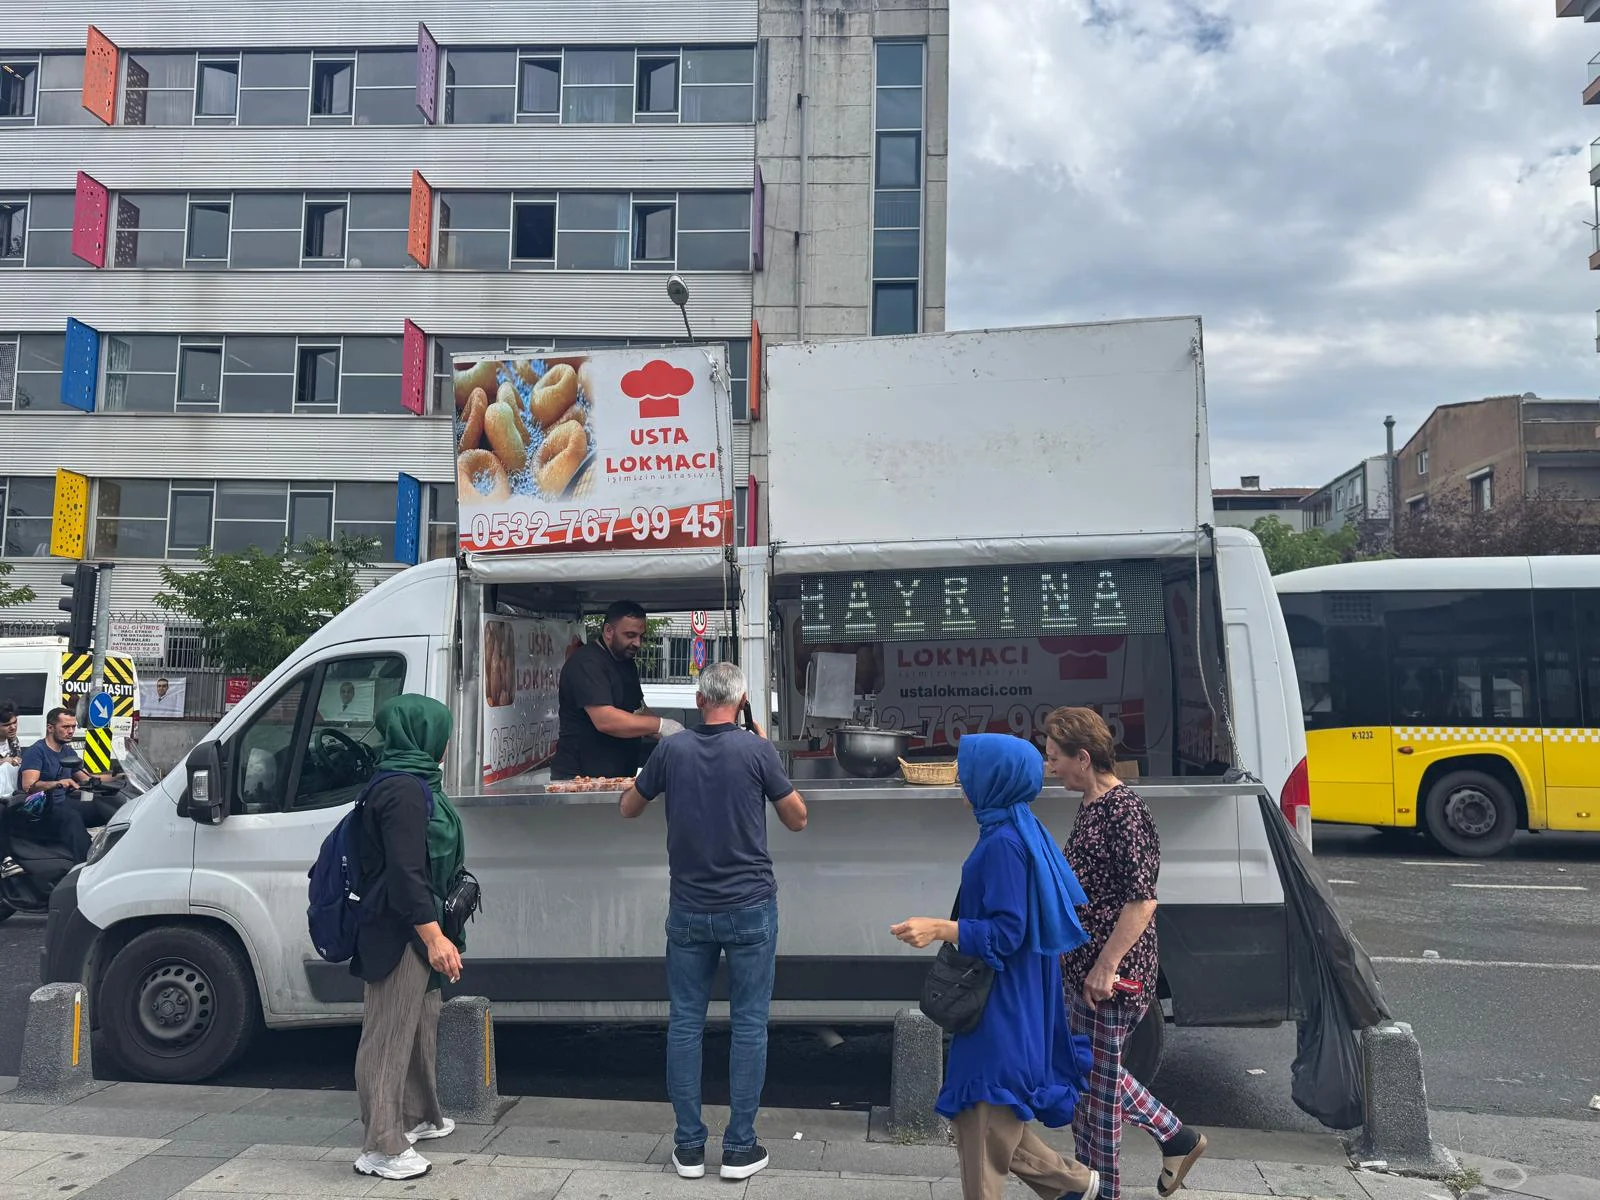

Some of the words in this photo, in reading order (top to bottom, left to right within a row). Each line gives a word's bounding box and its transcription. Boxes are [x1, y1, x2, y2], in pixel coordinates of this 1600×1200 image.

[630, 427, 689, 446] USTA
[606, 453, 716, 474] LOKMACI
[470, 511, 550, 548] 0532
[559, 508, 621, 544] 767
[630, 505, 670, 541] 99
[681, 504, 722, 539] 45
[800, 570, 1127, 627] HAYRINA
[694, 611, 705, 625] 30
[528, 632, 554, 657] USTA
[897, 645, 1029, 668] LOKMACI
[102, 683, 132, 697] TAŞITI
[516, 667, 560, 692] LOKMAC
[899, 683, 1033, 698] ustalokmaci.com
[920, 704, 994, 748] 767
[1351, 731, 1374, 740] K-1232
